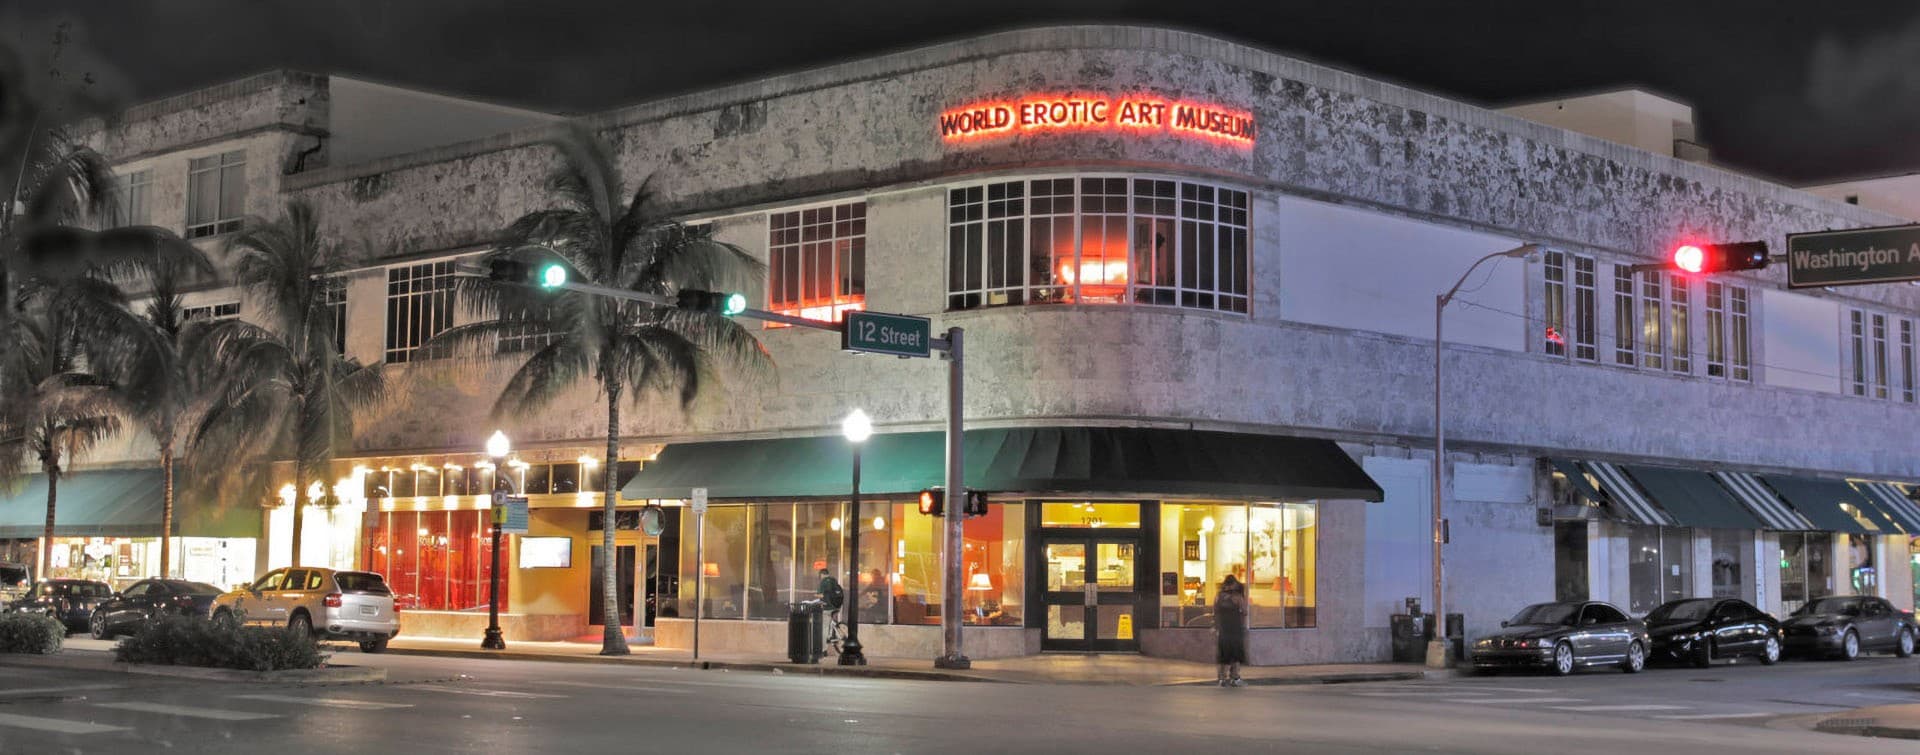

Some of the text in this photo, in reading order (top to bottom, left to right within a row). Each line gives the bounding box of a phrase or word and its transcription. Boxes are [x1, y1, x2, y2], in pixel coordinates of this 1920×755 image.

[941, 101, 1256, 140] WORLD EROTIC ART MUSEUM
[1794, 247, 1899, 271] Washington
[859, 321, 920, 346] 12 Street
[1082, 517, 1102, 525] 1201
